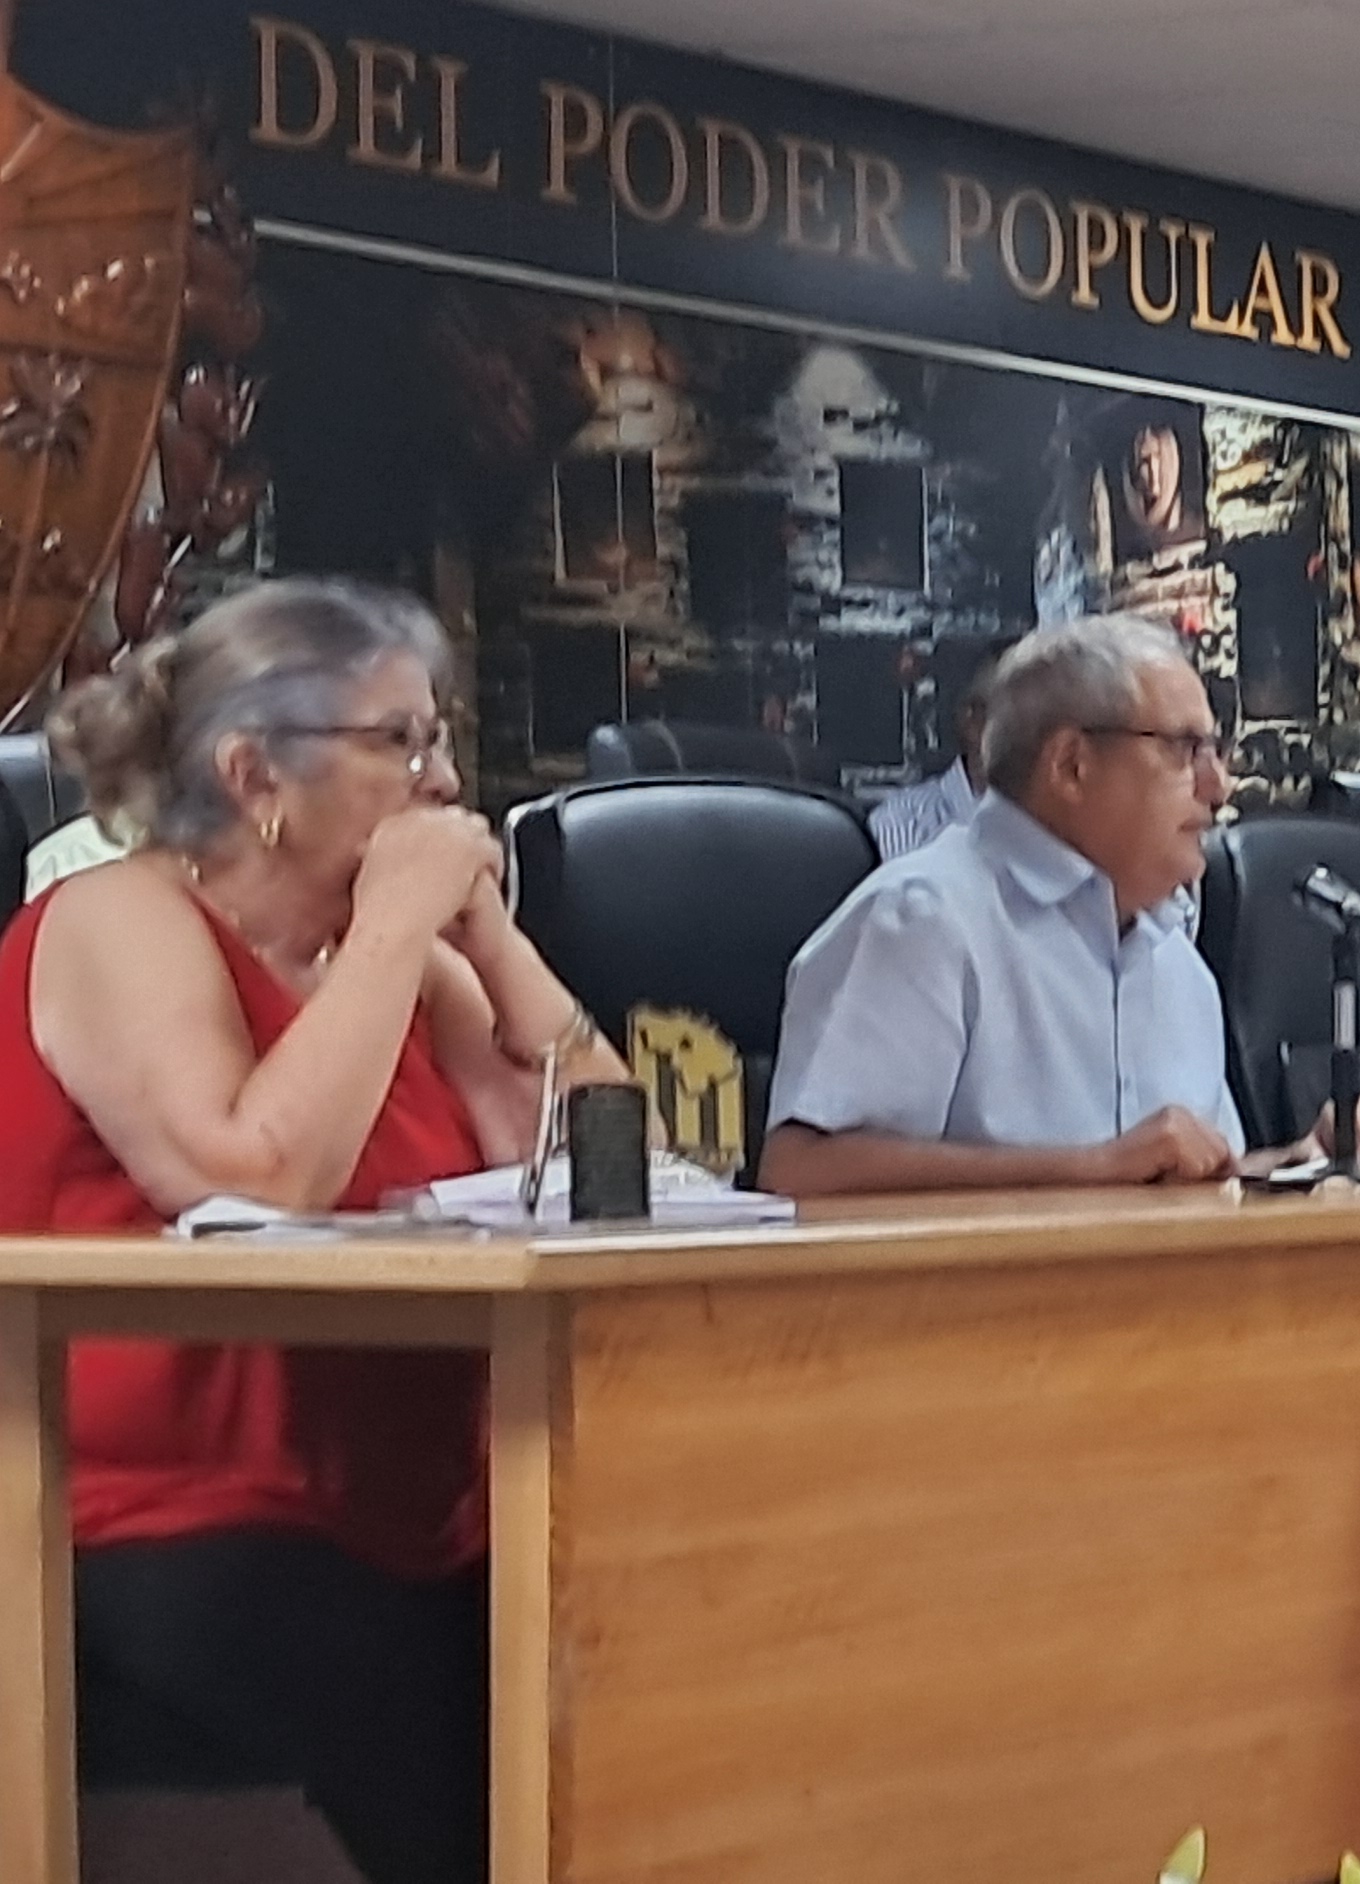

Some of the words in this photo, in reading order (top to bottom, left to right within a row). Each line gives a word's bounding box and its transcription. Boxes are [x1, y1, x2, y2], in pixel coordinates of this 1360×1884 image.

[248, 15, 502, 189] DEL
[540, 79, 916, 272] PODER
[942, 173, 1352, 361] POPULAR
